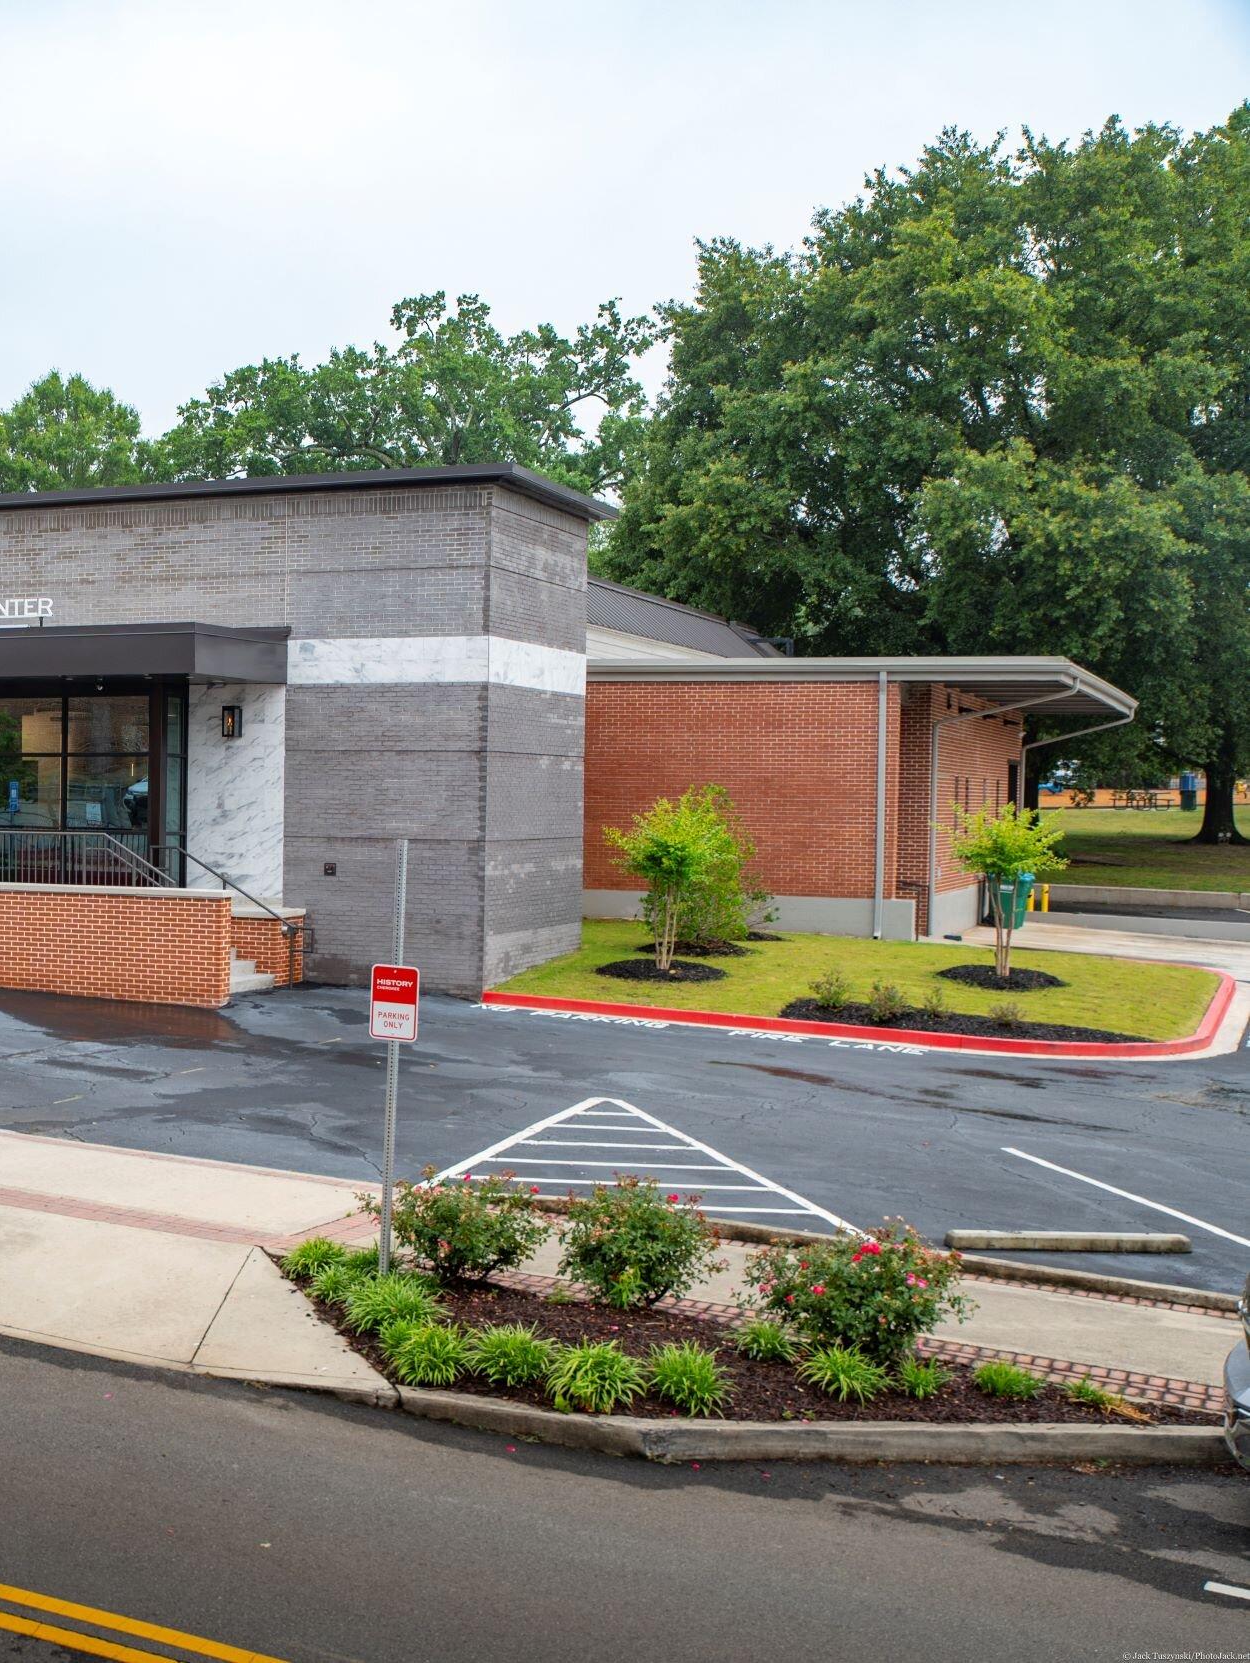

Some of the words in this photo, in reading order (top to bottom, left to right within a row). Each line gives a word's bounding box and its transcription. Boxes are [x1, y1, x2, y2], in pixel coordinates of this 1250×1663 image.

[376, 978, 413, 988] HISTORY
[378, 1011, 410, 1021] PARKING
[383, 1021, 403, 1029] ONLY
[469, 1003, 517, 1012] NO
[529, 1009, 670, 1029] PARKING
[727, 1030, 810, 1043] FIRE
[828, 1040, 930, 1056] LANE
